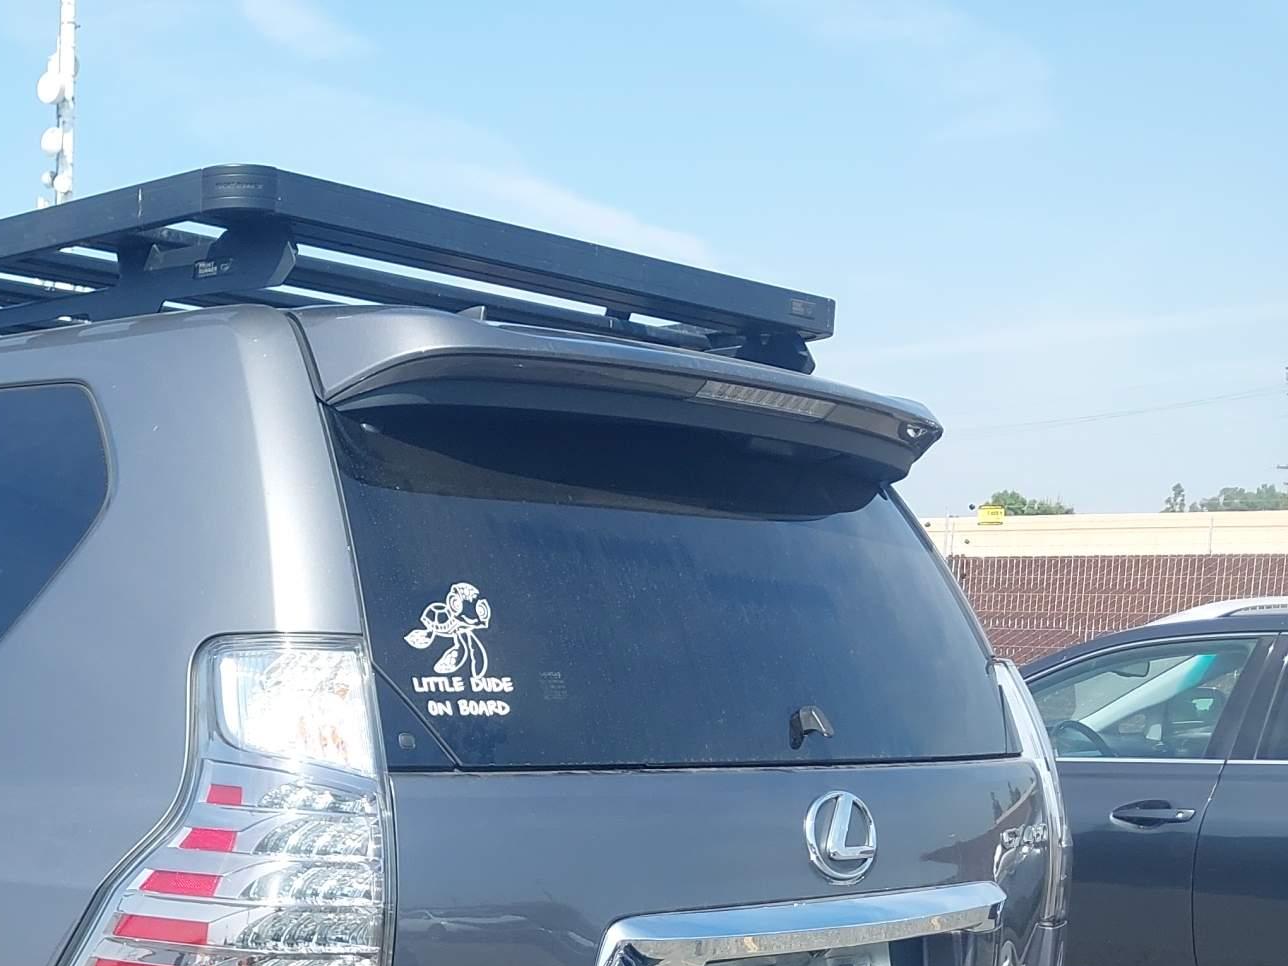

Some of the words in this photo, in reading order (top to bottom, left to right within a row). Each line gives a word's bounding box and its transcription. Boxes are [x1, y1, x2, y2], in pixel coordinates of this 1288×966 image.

[412, 676, 465, 693] LITTLE
[470, 676, 514, 693] DUDE
[428, 700, 454, 716] ON
[457, 699, 511, 717] BOARD
